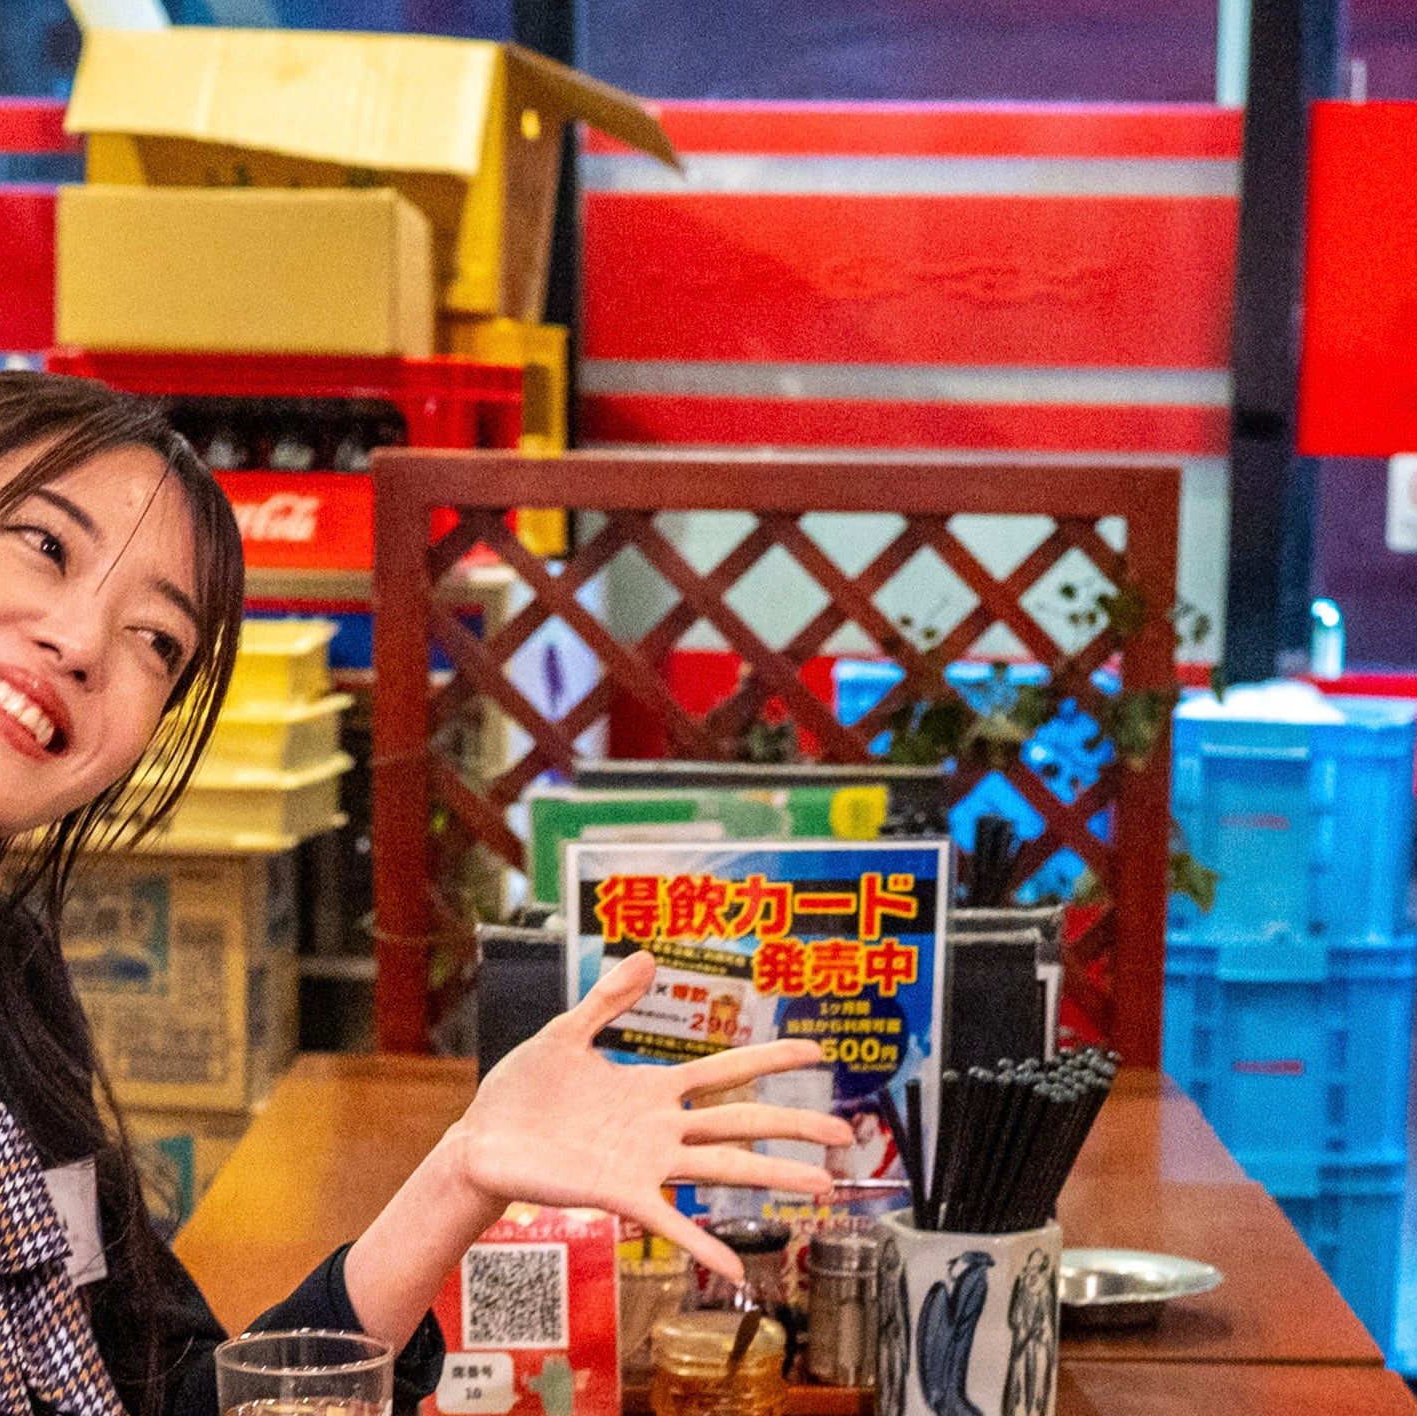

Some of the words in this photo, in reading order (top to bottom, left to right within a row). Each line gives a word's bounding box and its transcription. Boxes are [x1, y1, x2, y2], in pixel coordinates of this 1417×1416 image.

[596, 873, 917, 941] 得飲カード
[753, 938, 918, 997] 発売中
